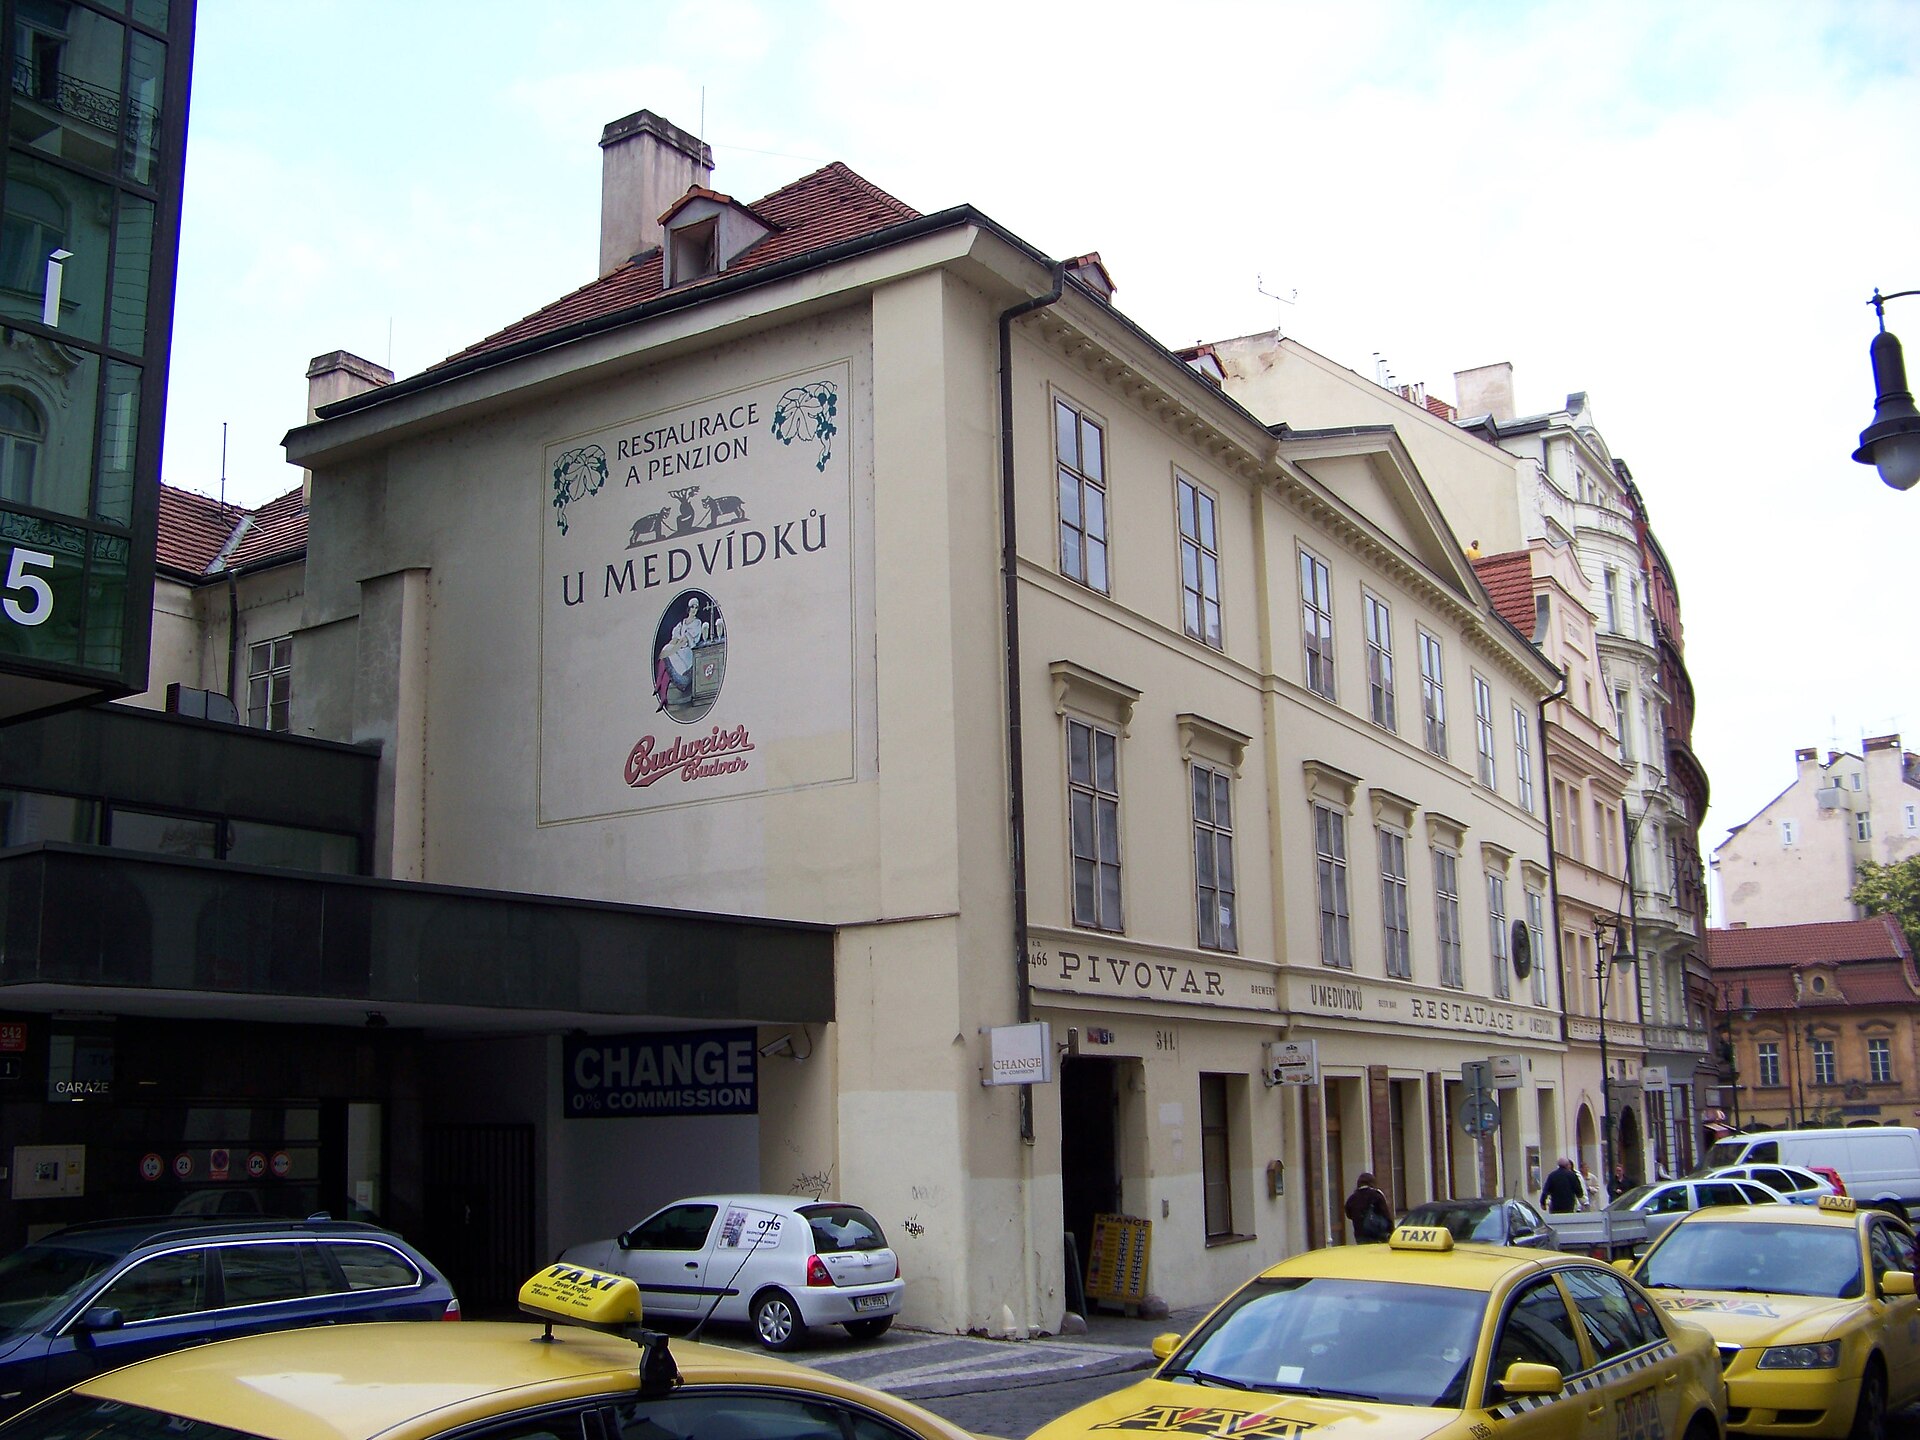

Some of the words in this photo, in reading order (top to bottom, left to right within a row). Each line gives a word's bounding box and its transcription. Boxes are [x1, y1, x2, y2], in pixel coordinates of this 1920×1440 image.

[617, 402, 760, 461] RESTAURACE
[625, 464, 641, 487] A
[648, 436, 749, 482] PENZION
[562, 571, 585, 607] U
[604, 508, 828, 599] MEDVÍDKŮ
[2, 546, 56, 626] 5
[624, 724, 756, 788] Budweiser
[681, 756, 749, 782] Budvar
[1058, 951, 1225, 997] PIVOVAR
[1251, 984, 1277, 996] BREWERY
[1311, 984, 1317, 1006] U
[1319, 984, 1363, 1011] MEDVÍDKŮ
[1411, 998, 1514, 1031] RESTAUACE
[1, 1026, 22, 1039] 342
[574, 1041, 754, 1089] CHANGE
[993, 1057, 1042, 1070] CHANGE
[55, 1078, 110, 1094] GARÁŽE
[572, 1093, 602, 1110] 0%
[607, 1087, 751, 1110] COMMISSION
[250, 1159, 263, 1169] LPG
[1822, 1195, 1852, 1208] TAXI
[758, 1220, 782, 1231] OTIS
[1098, 1215, 1150, 1228] CHANGE
[1401, 1228, 1437, 1243] TAXI
[547, 1264, 622, 1292] TAXI
